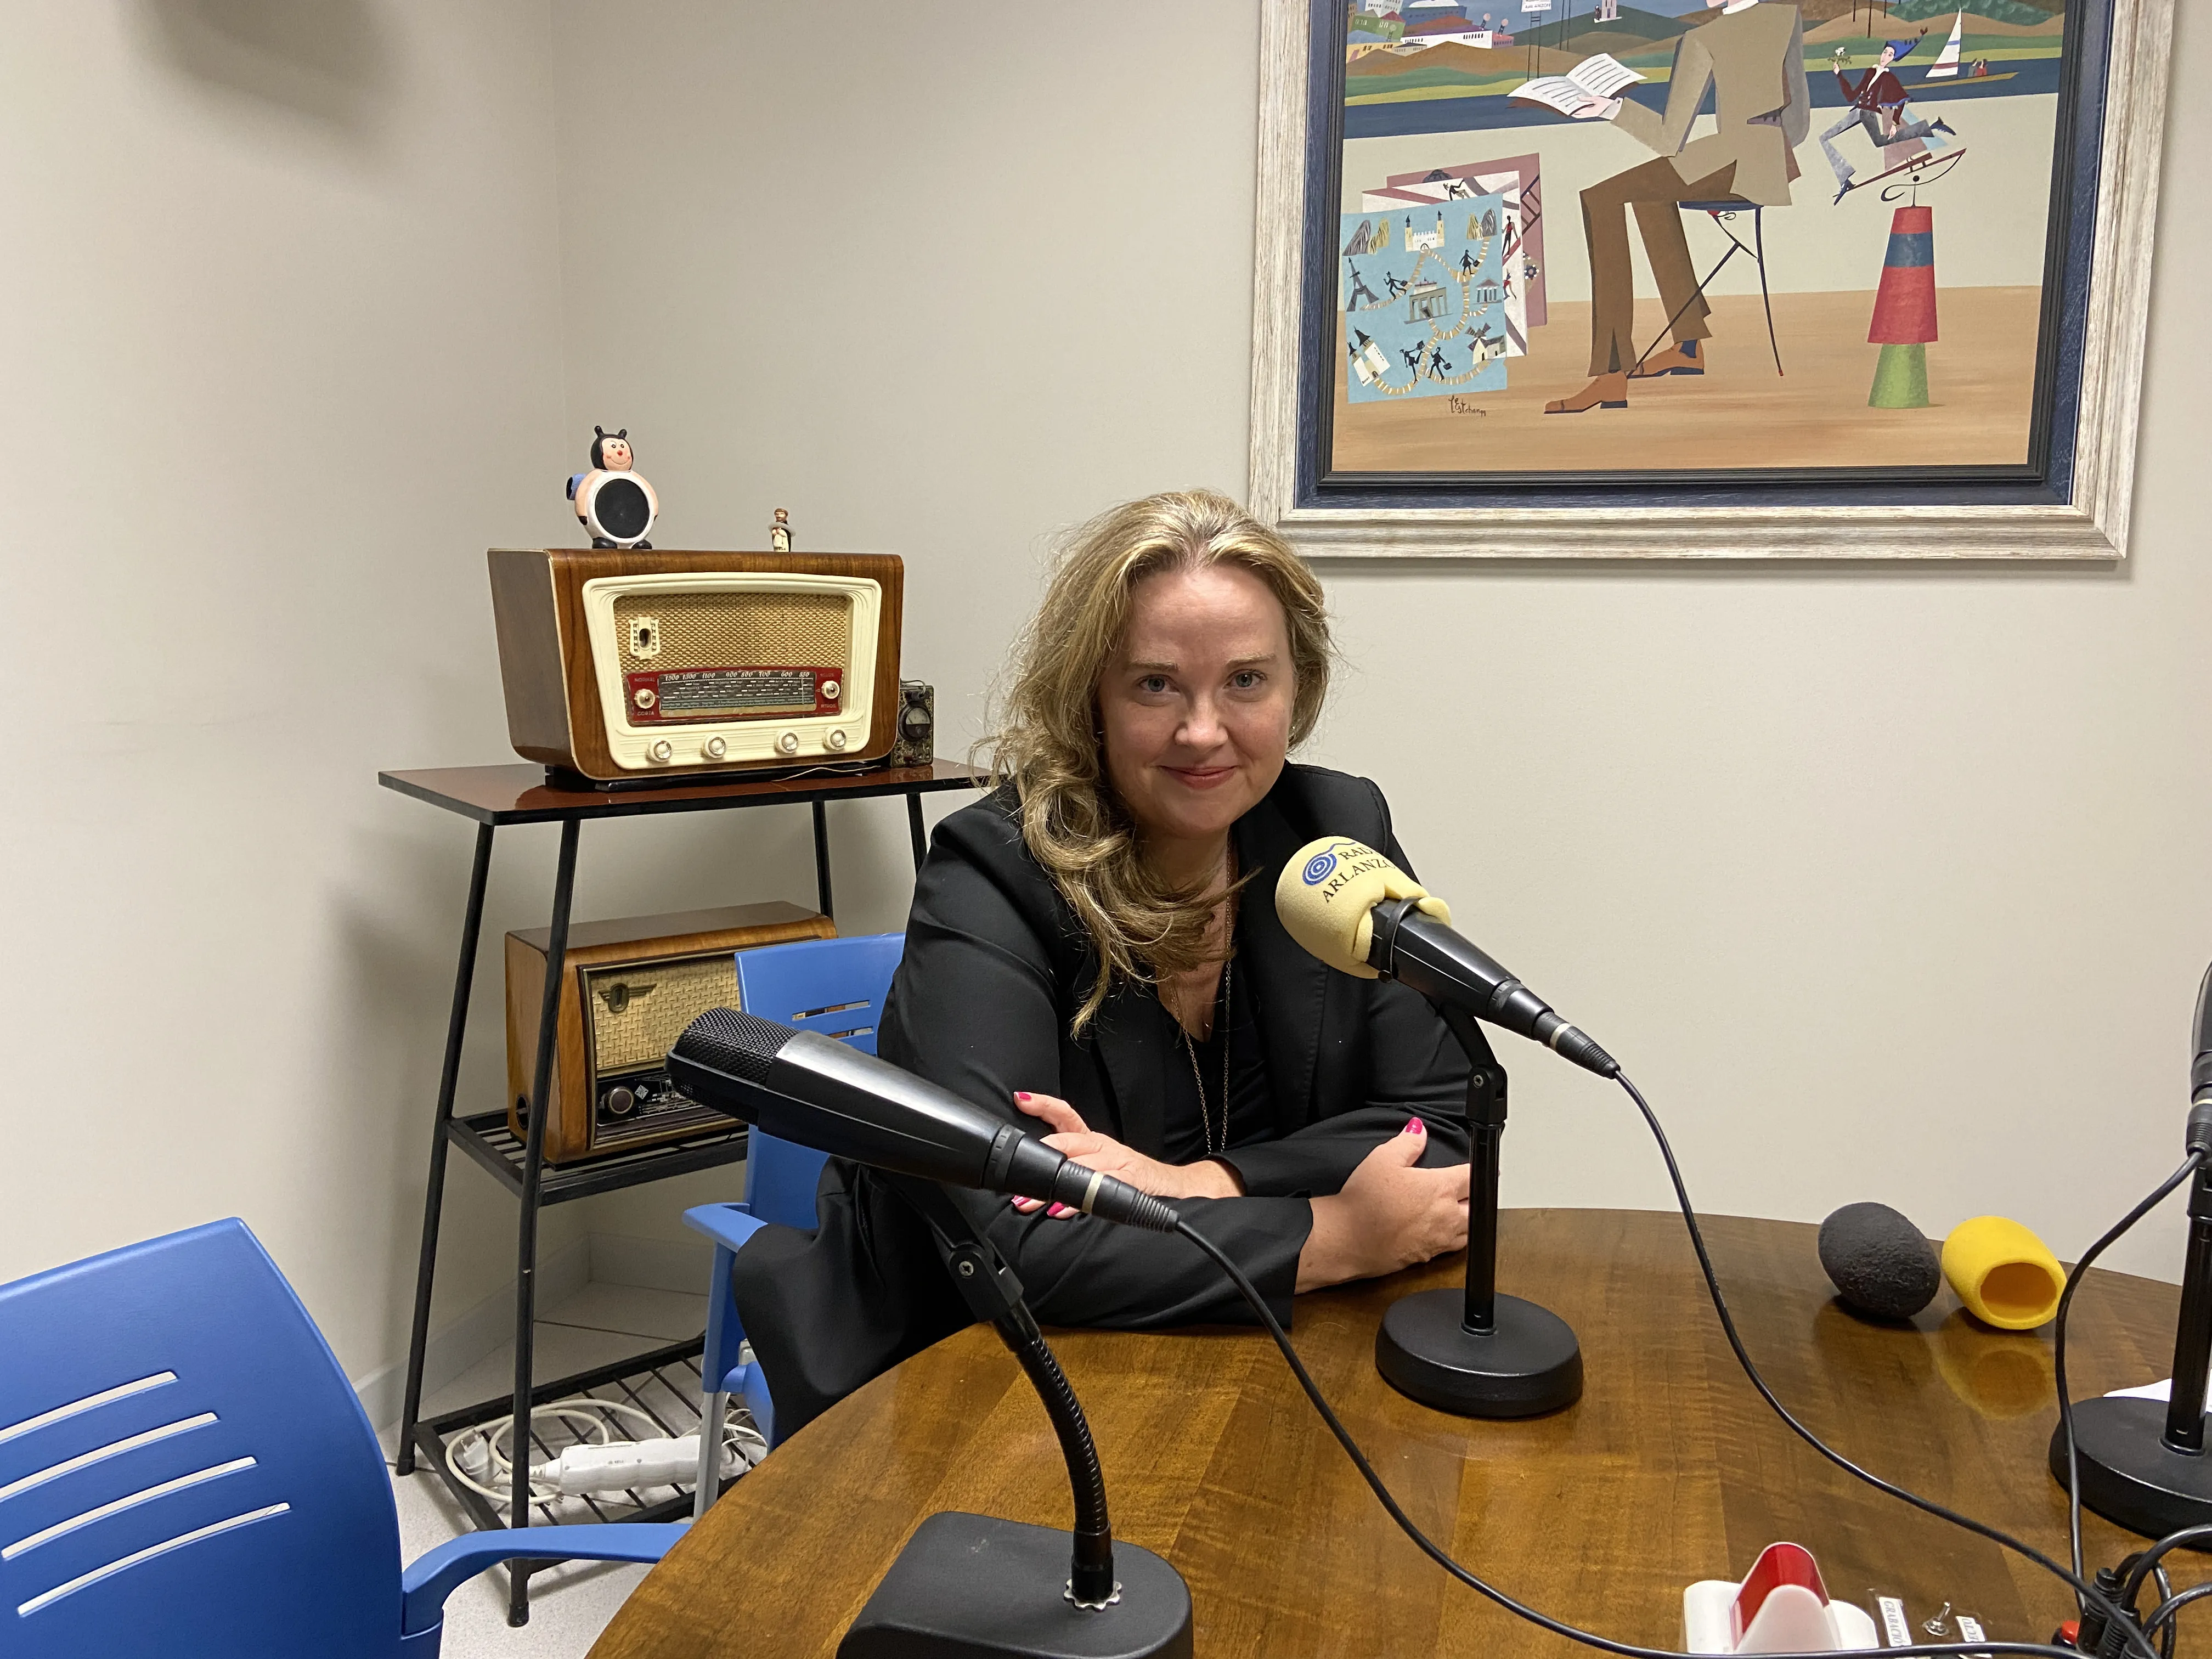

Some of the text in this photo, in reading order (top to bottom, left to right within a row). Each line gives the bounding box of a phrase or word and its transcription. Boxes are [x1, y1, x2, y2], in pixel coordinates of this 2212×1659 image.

[1338, 848, 1376, 860] RAD
[1883, 1601, 1905, 1644] GRABACIÓ
[1961, 1618, 1979, 1640] ECTO
